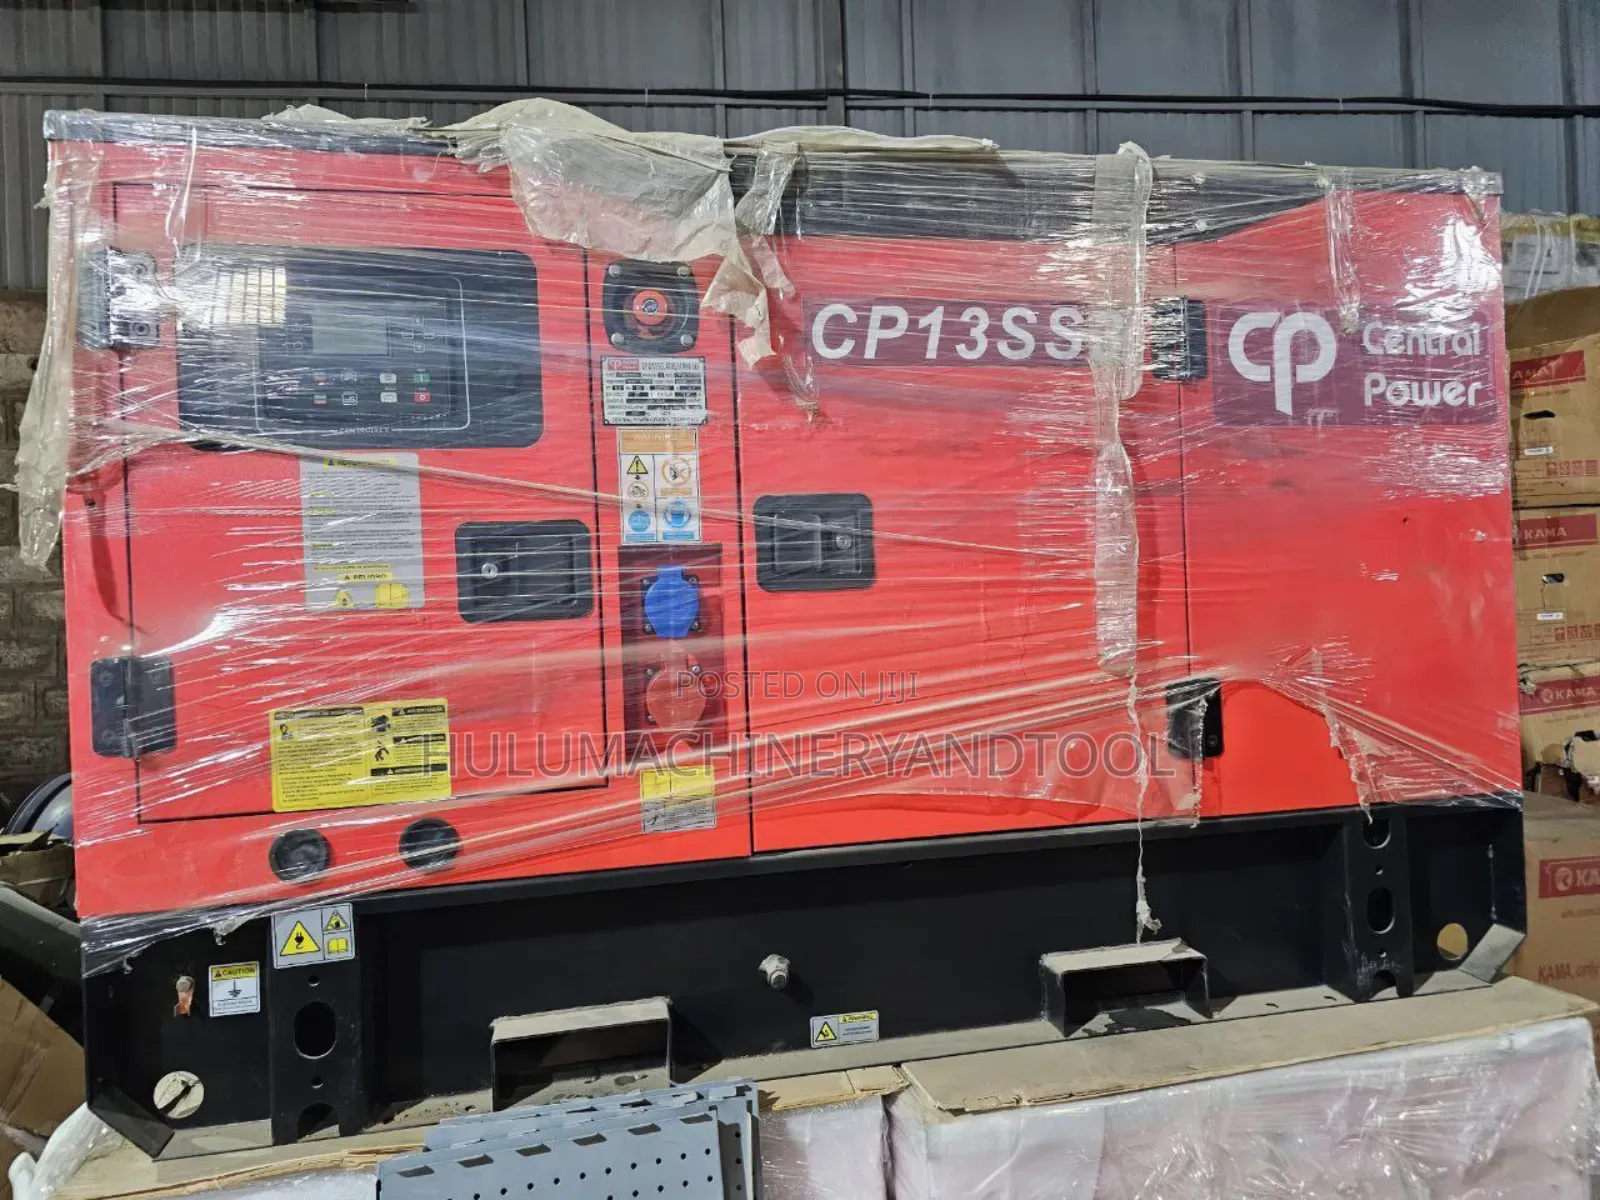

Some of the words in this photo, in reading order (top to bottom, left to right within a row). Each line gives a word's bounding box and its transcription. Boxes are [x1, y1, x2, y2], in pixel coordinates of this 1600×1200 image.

[1362, 321, 1481, 357] Central
[1364, 372, 1484, 407] Power
[1523, 527, 1568, 540] KAMA
[1555, 686, 1597, 701] KAMA
[222, 968, 256, 976] CAUTION
